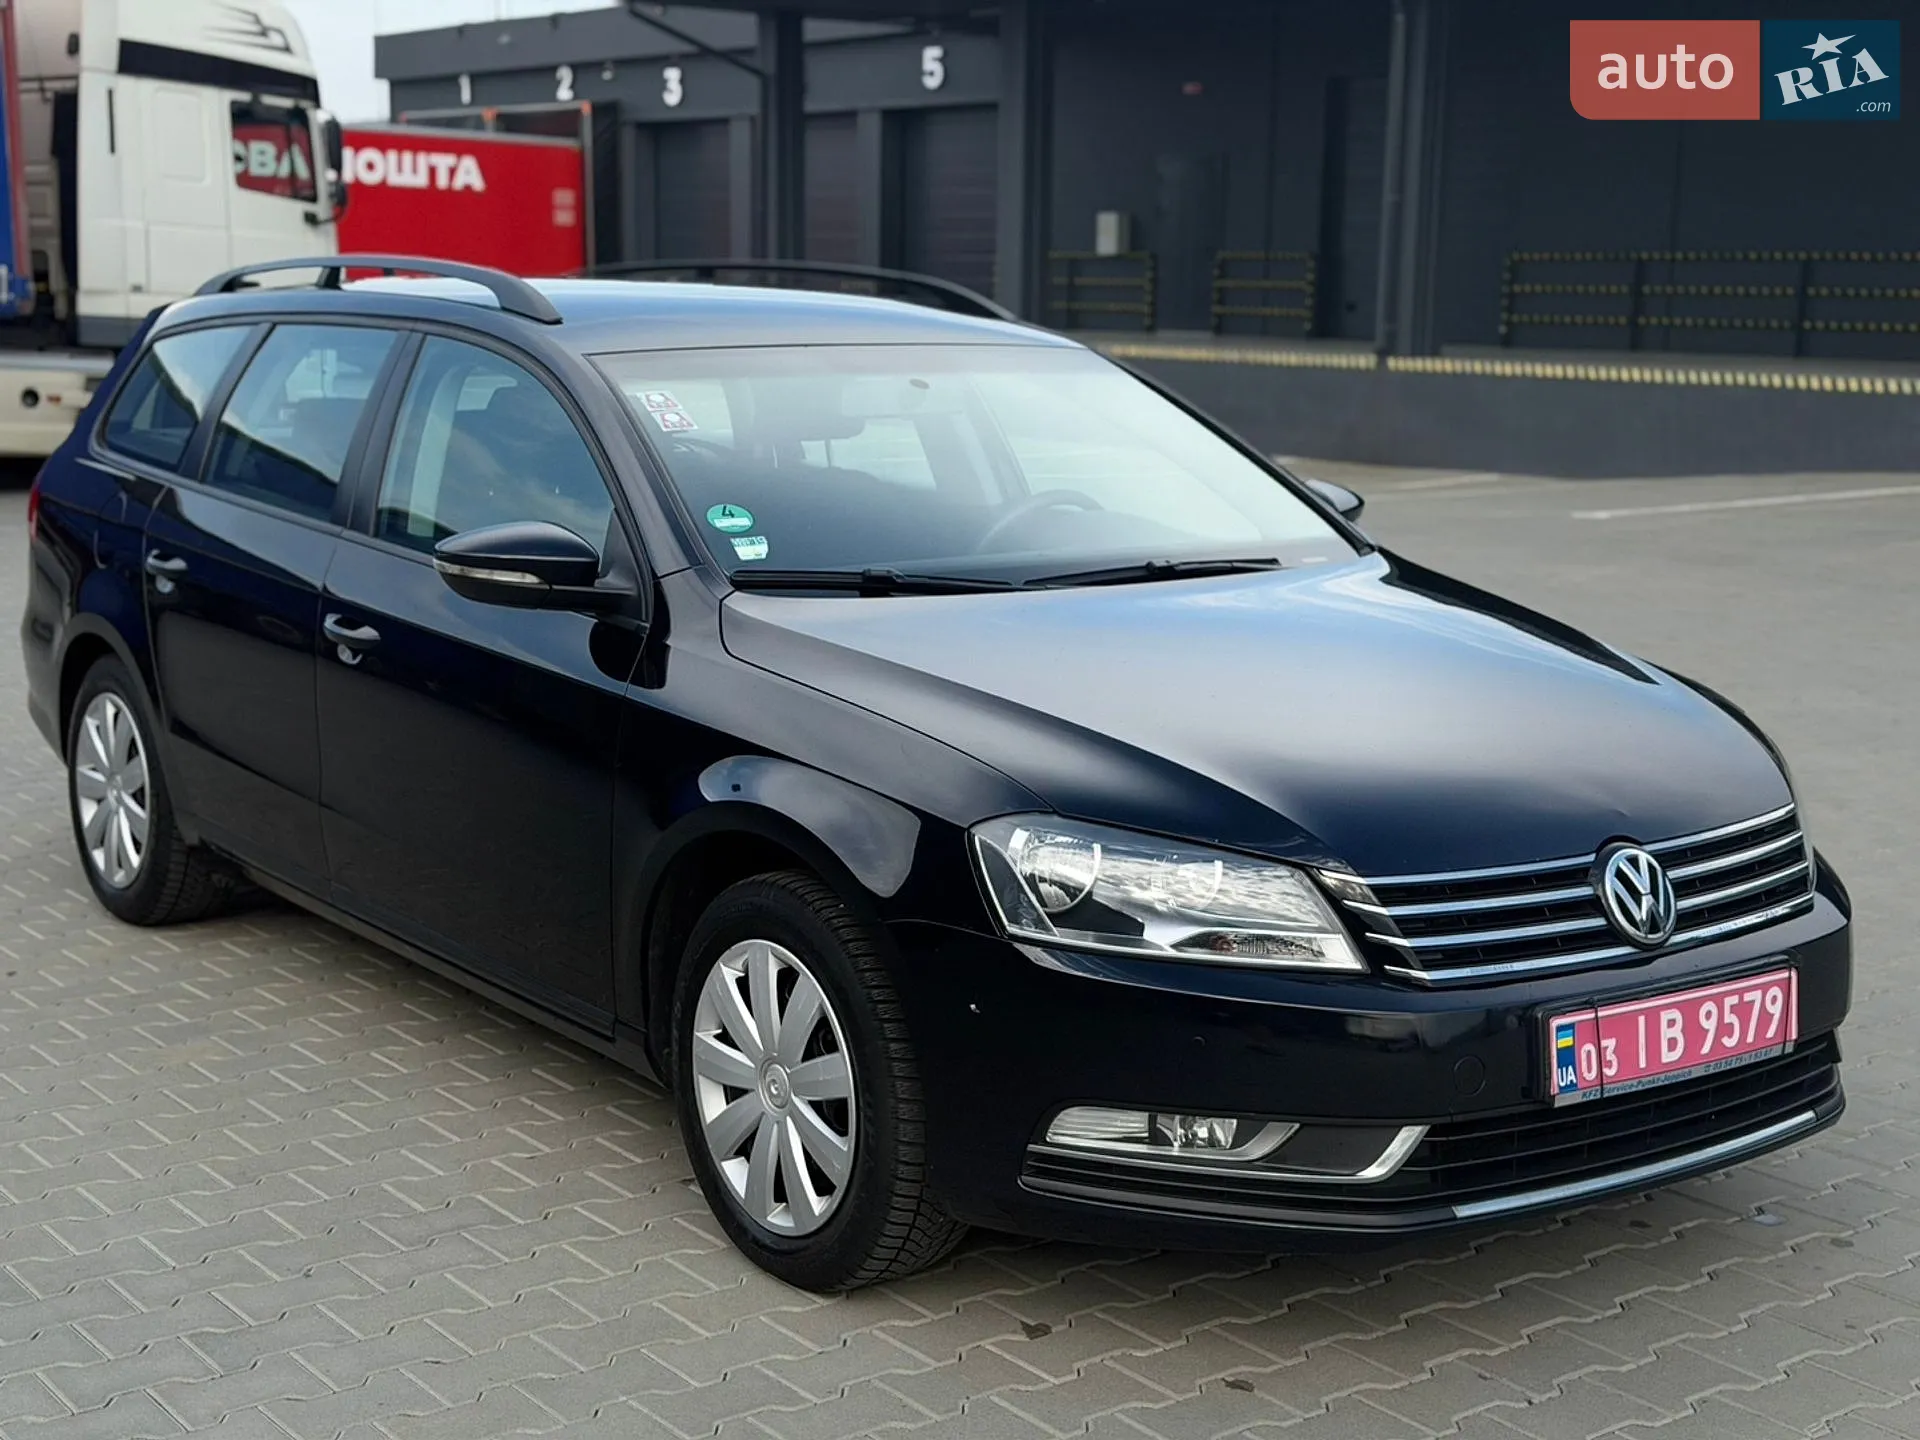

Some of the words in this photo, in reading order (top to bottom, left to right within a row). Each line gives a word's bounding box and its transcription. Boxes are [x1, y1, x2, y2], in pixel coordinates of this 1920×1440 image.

[556, 65, 574, 101] 2
[663, 66, 683, 107] 3
[922, 45, 945, 90] 5
[459, 73, 472, 105] 1
[722, 505, 735, 518] 4
[1557, 1064, 1577, 1087] UA
[1580, 1037, 1619, 1082] 03
[1637, 1008, 1687, 1070] IB
[1698, 985, 1784, 1056] 9579
